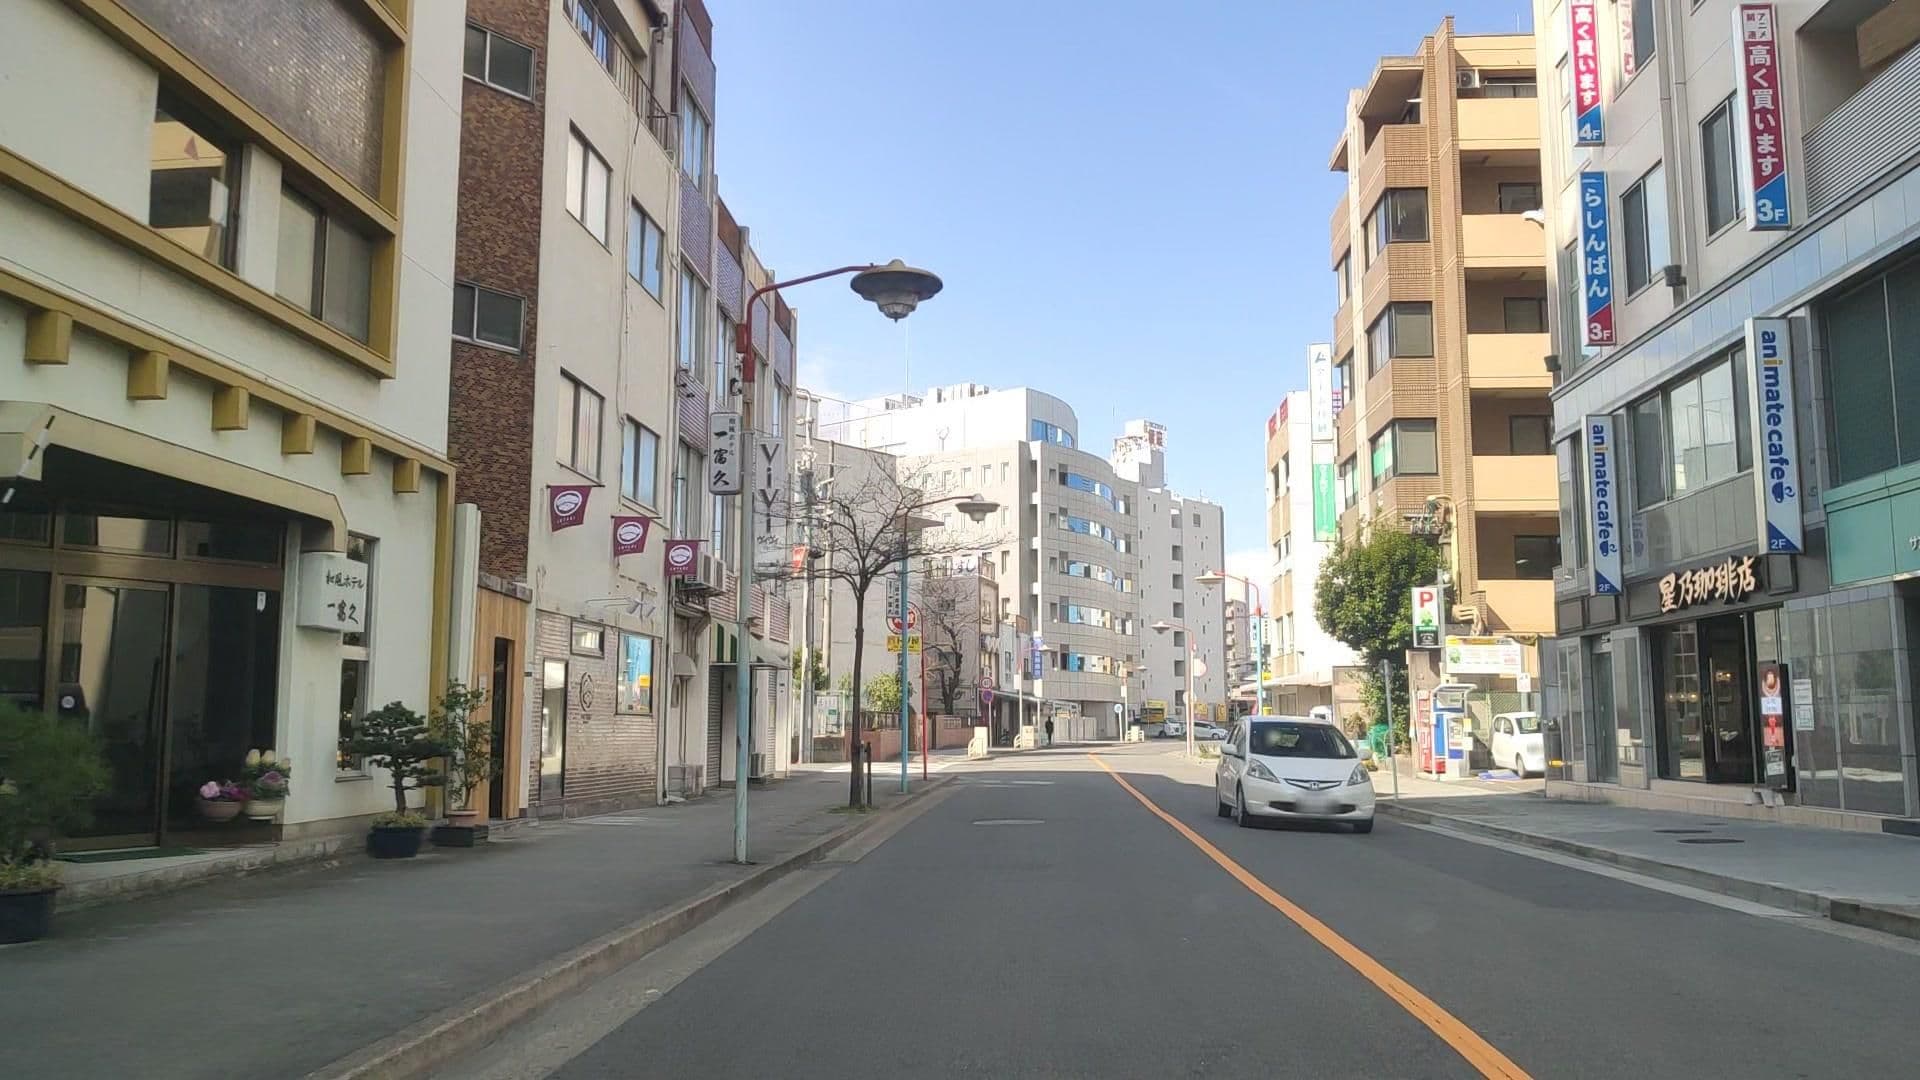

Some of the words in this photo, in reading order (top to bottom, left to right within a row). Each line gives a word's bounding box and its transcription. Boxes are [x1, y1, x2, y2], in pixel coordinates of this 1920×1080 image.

[1749, 45, 1778, 176] 高く買います
[1579, 123, 1600, 140] 4F
[1757, 199, 1785, 222] 3F
[1585, 188, 1608, 298] らしんばん
[1589, 322, 1612, 341] 3F
[713, 430, 730, 486] 一富久
[1771, 539, 1786, 550] 2F
[1909, 536, 1920, 551] サ
[1599, 583, 1611, 593] 2F
[1659, 555, 1756, 613] 星乃珈琲店
[1420, 591, 1433, 608] P
[327, 599, 359, 625] 一富久
